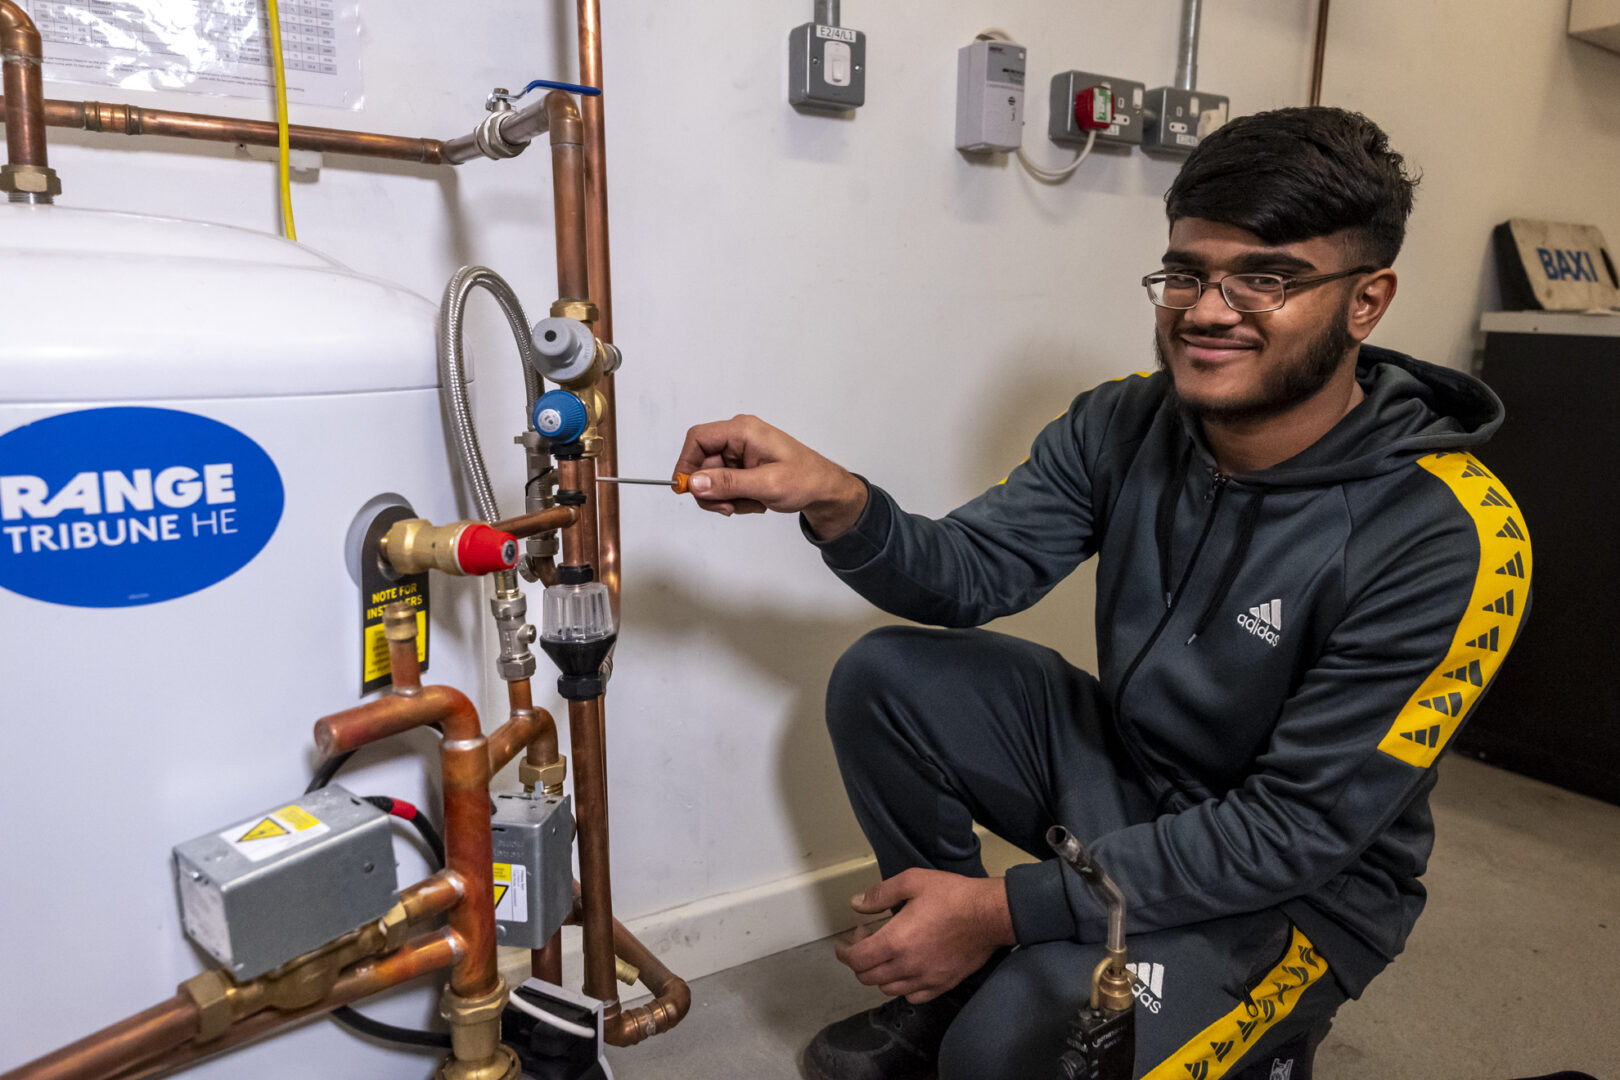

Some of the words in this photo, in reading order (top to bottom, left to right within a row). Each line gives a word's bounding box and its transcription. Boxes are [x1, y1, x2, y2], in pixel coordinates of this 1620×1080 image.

[820, 27, 854, 41] E2/4/L1
[1536, 248, 1599, 283] BAXI
[0, 463, 236, 520] RANGE
[3, 514, 181, 554] TRIBUNE
[192, 508, 238, 537] HE
[366, 595, 423, 620] INSERS
[372, 587, 397, 605] NOTE
[399, 583, 417, 596] FOR
[1237, 613, 1280, 647] adidas
[1131, 983, 1162, 1014] das
